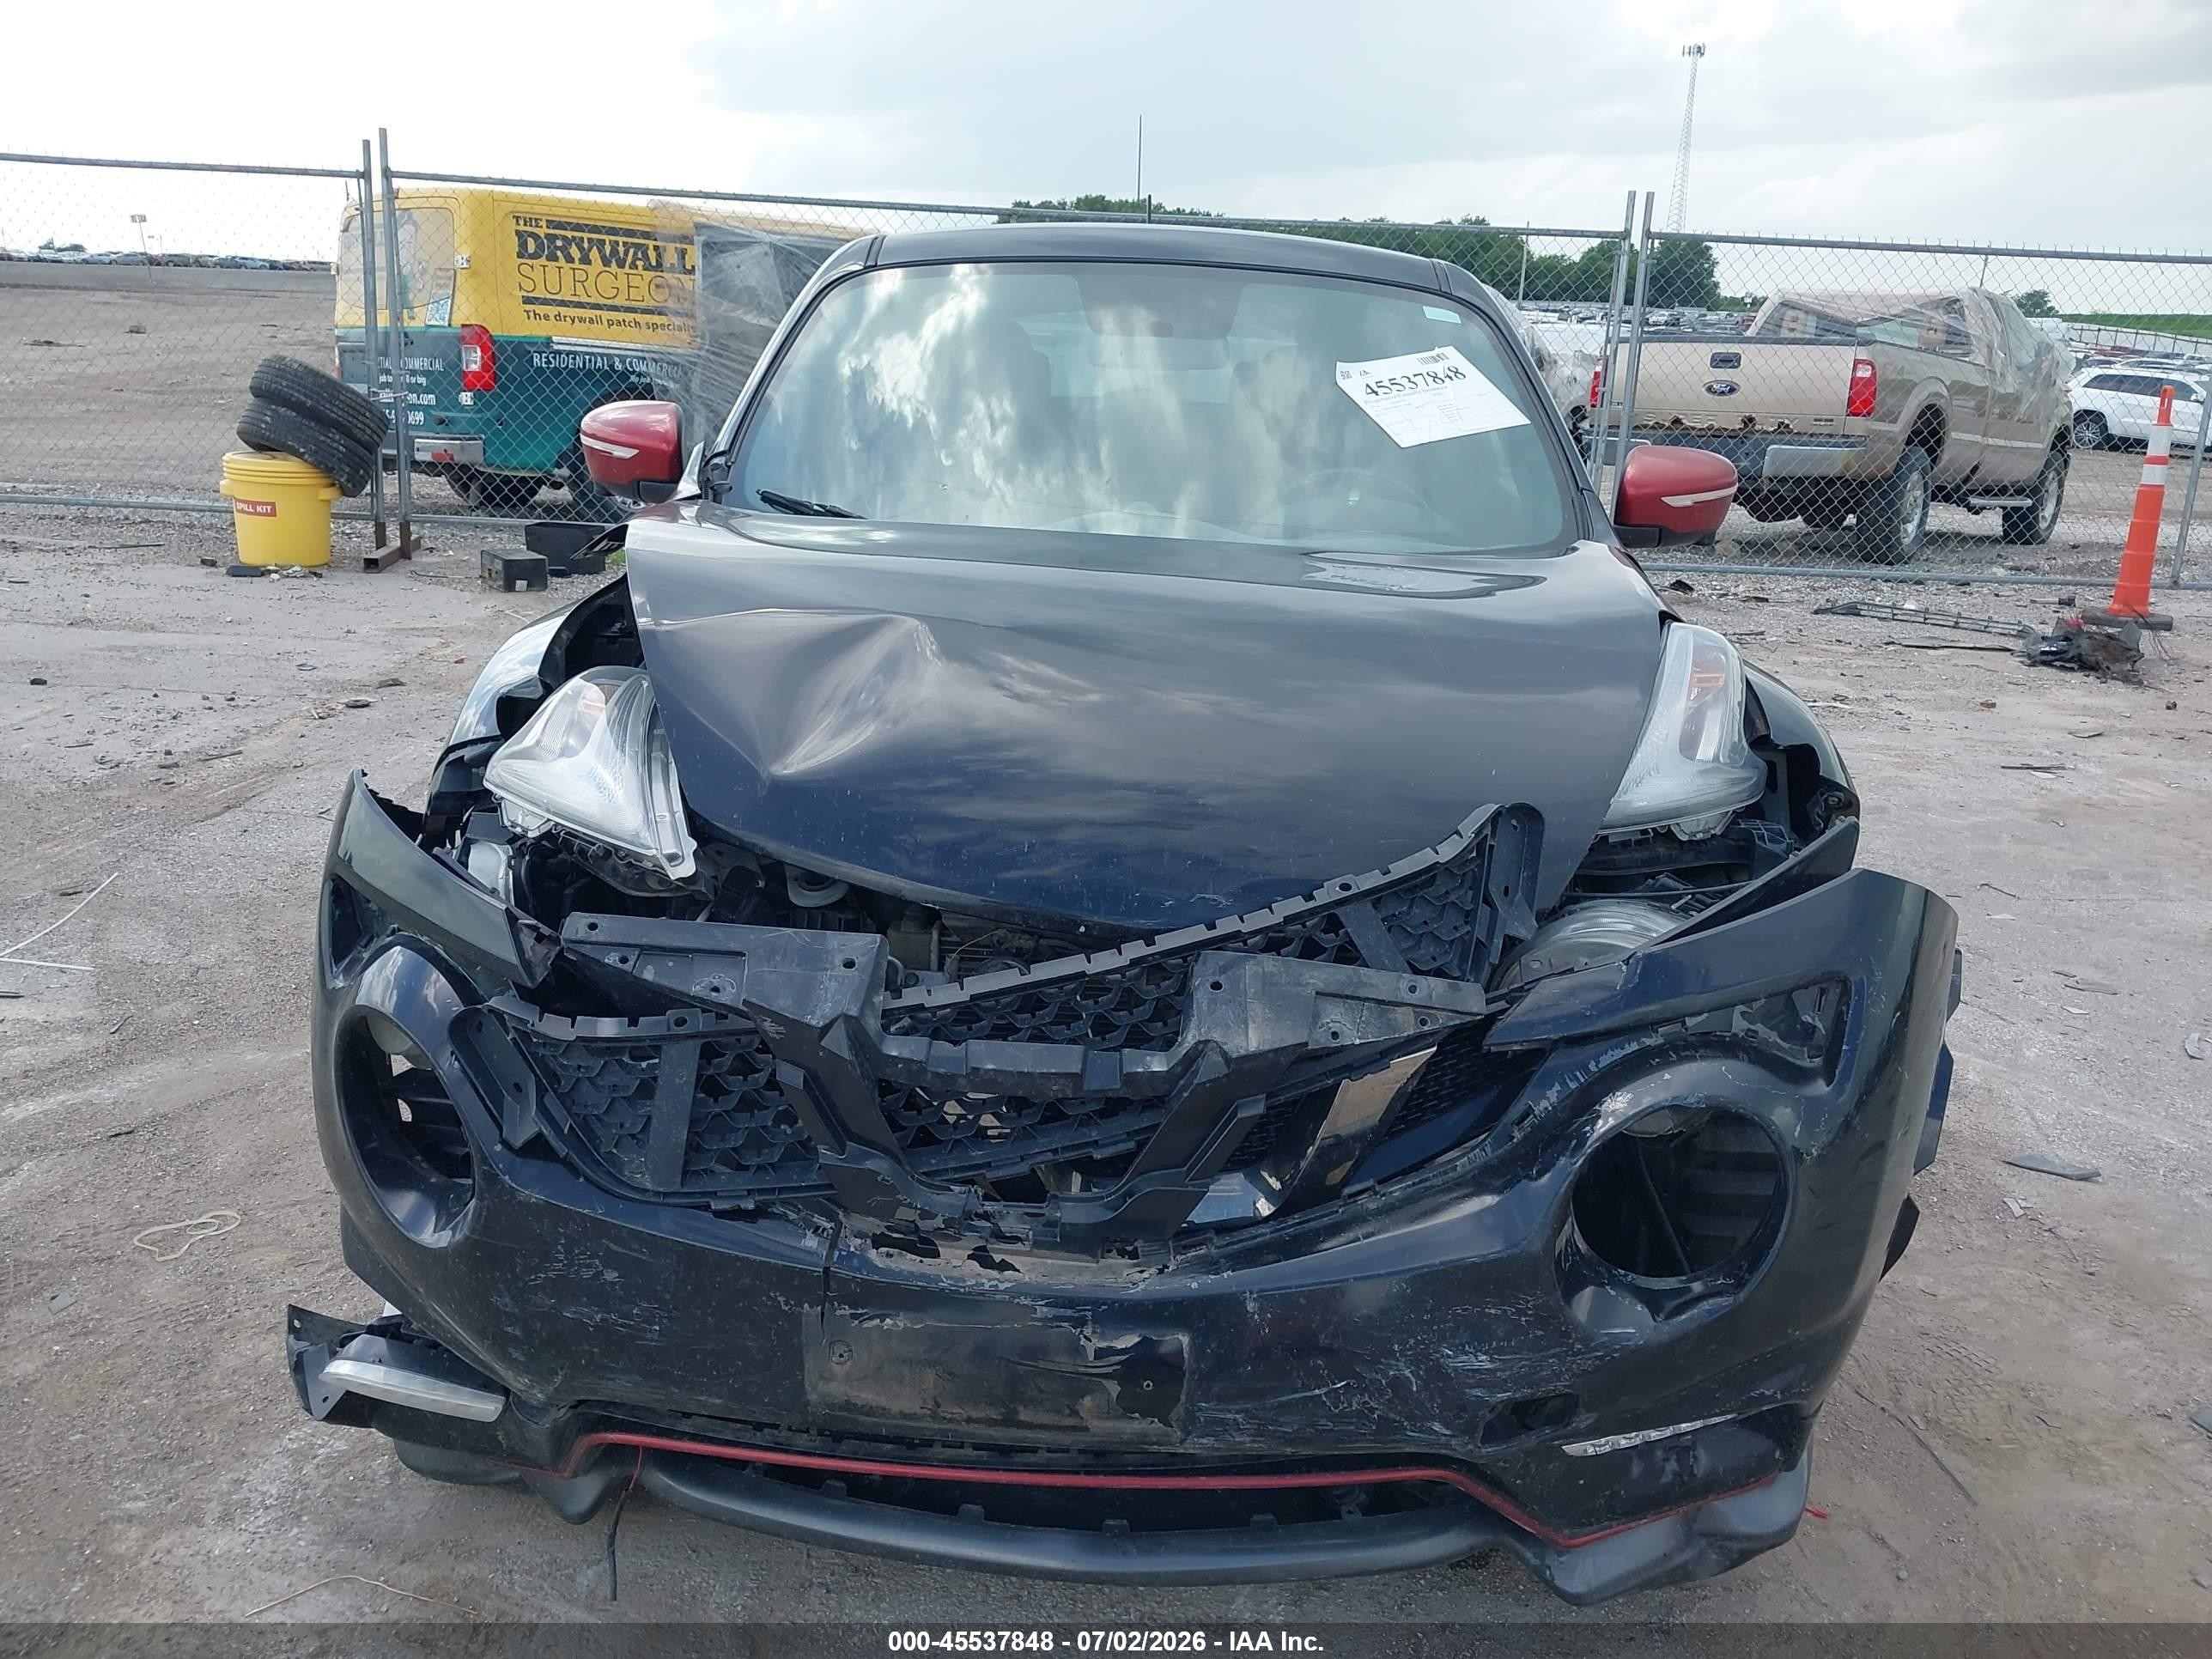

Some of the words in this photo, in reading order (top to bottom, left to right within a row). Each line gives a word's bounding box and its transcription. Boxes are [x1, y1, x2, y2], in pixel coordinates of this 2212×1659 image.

[513, 215, 543, 228] THE
[515, 229, 696, 276] DRYWALL
[523, 309, 550, 321] The
[553, 313, 604, 326] drywall
[606, 318, 641, 330] patch
[532, 353, 610, 370] RESIDENTIAL
[613, 358, 623, 371] &
[416, 374, 427, 387] big
[1365, 365, 1467, 397] 45537848
[235, 501, 255, 513] SPILL
[256, 504, 273, 514] KIT
